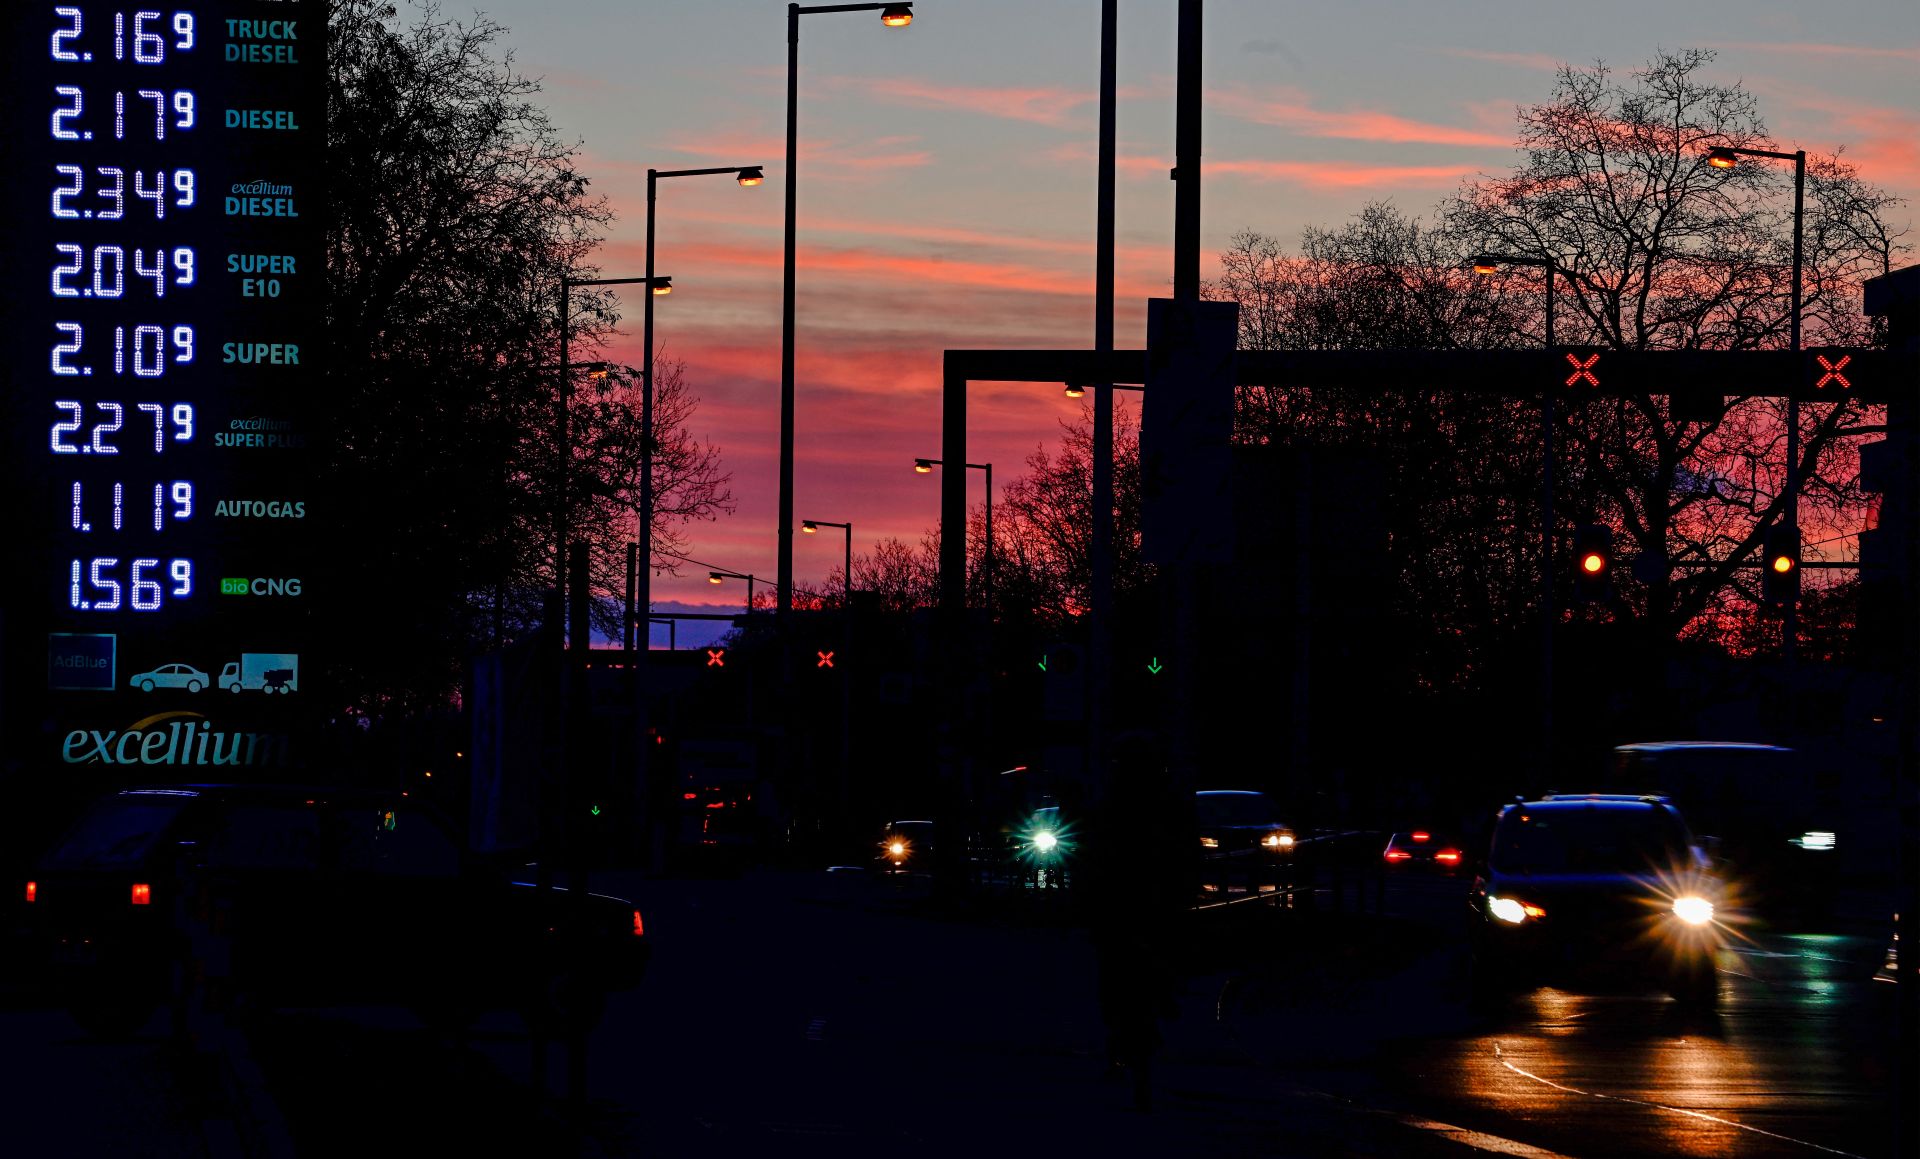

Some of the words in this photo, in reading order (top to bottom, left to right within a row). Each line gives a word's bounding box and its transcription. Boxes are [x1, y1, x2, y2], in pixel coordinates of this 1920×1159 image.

[51, 6, 195, 63] 2.169
[225, 19, 297, 39] TRUCK
[225, 43, 298, 64] DIESEL
[51, 85, 196, 141] 2.179
[225, 109, 299, 130] DIESEL
[51, 164, 196, 220] 2.349
[231, 180, 292, 195] excellium
[225, 197, 299, 217] DIESEL
[51, 243, 196, 298] 2.049
[227, 253, 296, 275] SUPER
[242, 278, 281, 298] E10
[51, 322, 195, 377] 2.109
[222, 342, 299, 365] SUPER
[50, 400, 195, 454] 2.279
[230, 416, 291, 431] excellium
[214, 432, 264, 447] SUPER
[71, 480, 194, 532] 1.119
[214, 499, 306, 519] AUTOGAS
[70, 557, 194, 612] 1.569
[54, 655, 109, 669] AdBlue
